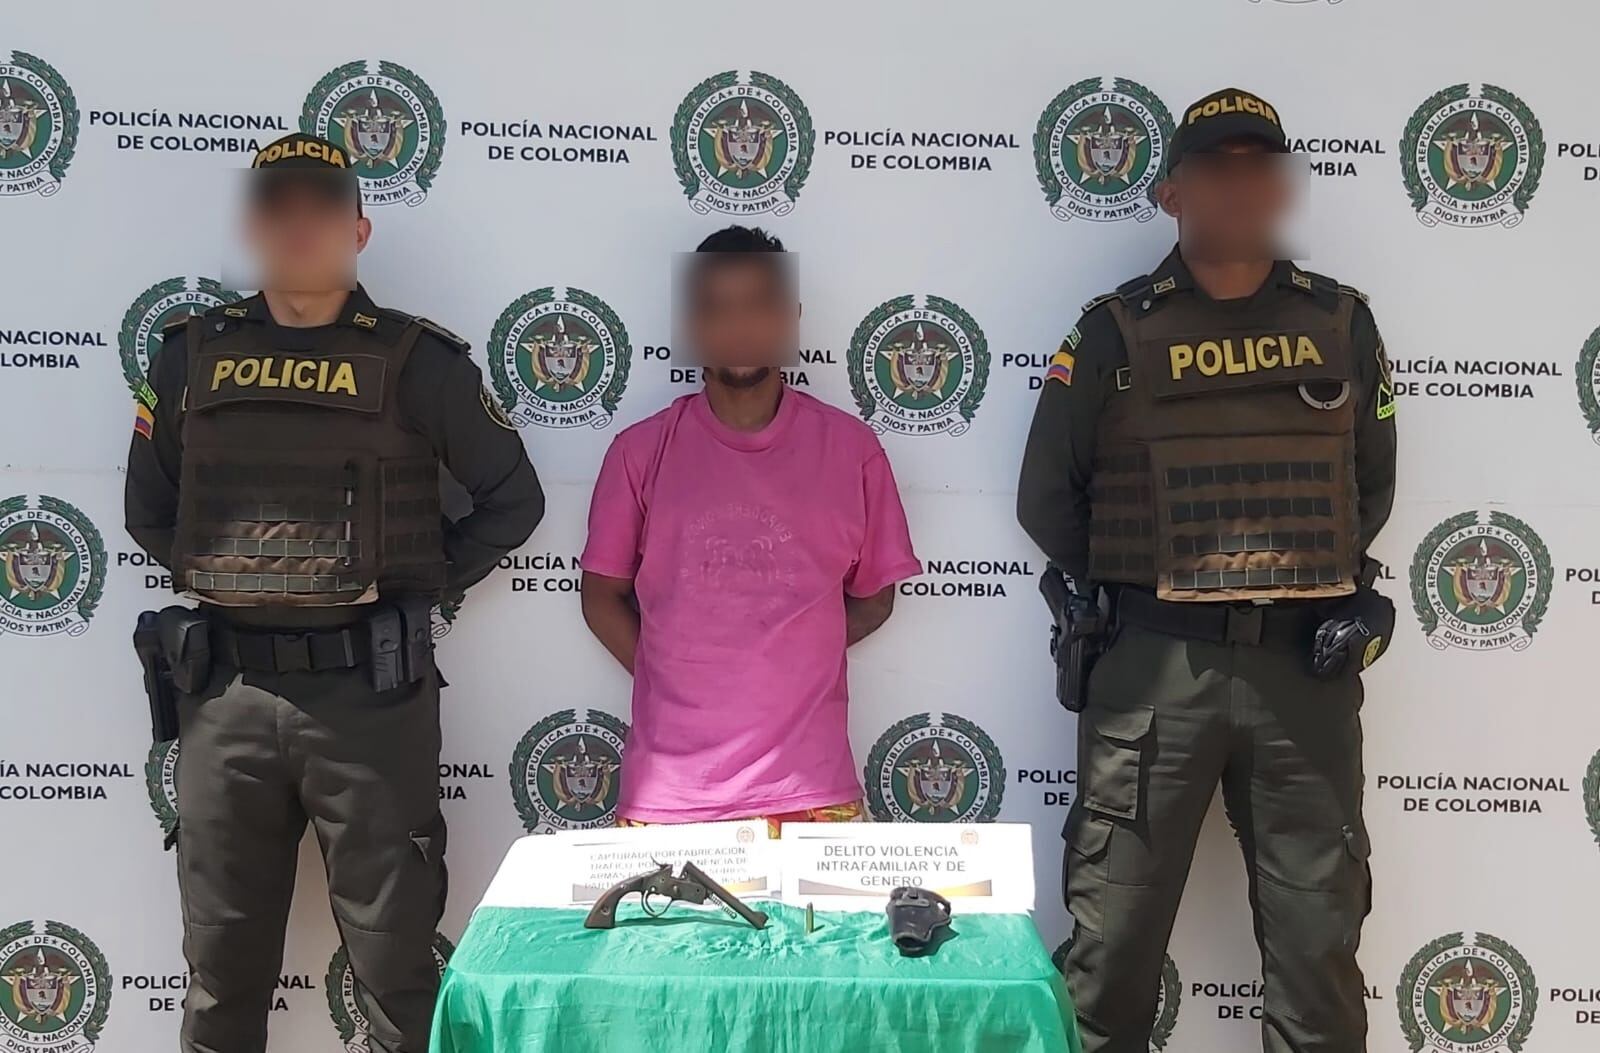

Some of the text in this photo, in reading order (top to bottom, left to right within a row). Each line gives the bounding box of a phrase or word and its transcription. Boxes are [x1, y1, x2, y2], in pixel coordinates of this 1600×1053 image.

[0, 67, 61, 132] DE COLOMBIA
[366, 77, 382, 86] DE
[394, 84, 428, 142] COLOMBIA
[1188, 96, 1278, 125] POLICIA
[90, 109, 288, 130] POLICÍA NACIONAL
[737, 87, 753, 96] DE
[764, 94, 797, 152] COLOMBIA
[1101, 94, 1117, 102] DE
[1128, 101, 1160, 158] COLOMBIA
[462, 120, 657, 140] POLICÍA NACIONAL
[824, 128, 1020, 149] POLICÍA NACIONAL
[1468, 100, 1484, 108] DE
[1495, 107, 1527, 164] COLOMBIA
[118, 135, 259, 152] DE COLOMBIA
[7, 146, 56, 179] NACIONAL
[254, 141, 345, 168] POLICIA
[489, 146, 629, 163] DE COLOMBIA
[851, 155, 992, 171] DE COLOMBIA
[374, 156, 423, 189] NACIONAL
[1310, 162, 1357, 176] MBIA
[6, 177, 46, 194] PATRIA
[742, 165, 792, 199] NACIONAL
[1104, 172, 1154, 205] NACIONAL
[373, 187, 413, 204] PATRIA
[705, 193, 731, 211] DIOS
[741, 196, 781, 213] PATRIA
[1471, 177, 1521, 211] NACIONAL
[1067, 200, 1093, 218] DIOS
[1103, 203, 1143, 220] PATRIA
[1433, 206, 1459, 224] DIOS
[1470, 208, 1509, 225] PATRIA
[185, 293, 201, 301] DE
[0, 331, 107, 346] NACIONAL
[554, 304, 569, 312] DE
[580, 310, 613, 366] COLOMBIA
[913, 311, 929, 320] DE
[940, 318, 972, 374] COLOMBIA
[1, 353, 79, 368] LOMBIA
[1003, 354, 1053, 368] POLI
[1169, 335, 1324, 380] POLICIA
[211, 357, 358, 396] POLICIA
[670, 369, 697, 384] DE
[1455, 361, 1562, 376] NACIONAL
[560, 379, 609, 412] NACIONAL
[1394, 382, 1533, 398] DE COLOMBIA
[918, 387, 967, 420] NACIONAL
[523, 407, 549, 424] DIOS
[559, 410, 598, 426] PATRIA
[881, 414, 906, 432] DIOS
[917, 417, 956, 434] PATRIA
[27, 511, 42, 520] DE
[54, 518, 89, 573] COLOMBIA
[498, 553, 565, 570] OLICÍA
[1477, 527, 1492, 535] DE
[1504, 533, 1535, 589] COLOMBIA
[928, 561, 1034, 575] NACIONAL
[145, 576, 172, 589] DE
[512, 578, 537, 591] DE
[900, 582, 1007, 597] COLOMBIA
[35, 586, 84, 620] NACIONAL
[35, 617, 75, 634] PATRIA
[1480, 602, 1530, 634] NACIONAL
[1443, 630, 1468, 647] DIOS
[1479, 632, 1518, 648] PATRIA
[575, 725, 590, 733] DE
[929, 729, 945, 737] DE
[956, 735, 988, 790] COLOMBIA
[26, 764, 134, 777] NACIONAL
[440, 764, 494, 777] ONAL
[1018, 770, 1076, 784] POLIC
[1378, 773, 1569, 791] POLICÍA NACIONAL
[0, 786, 107, 799] COLOMBIA
[1044, 792, 1070, 806] DE
[1404, 798, 1541, 813] DE COLOMBIA
[581, 809, 617, 830] NACIO
[655, 849, 676, 858] POR
[824, 845, 959, 857] DELITO VIOLENCIA
[816, 860, 965, 872] INTRAFAMILIAR Y DE
[860, 875, 923, 887] GENERO
[33, 936, 49, 945] DE
[60, 942, 94, 997] COLOMBIA
[123, 972, 187, 989] POLICÍ
[1463, 948, 1478, 956] DE
[1489, 954, 1520, 1008] COLOMBIA
[150, 998, 174, 1011] DE
[1218, 1006, 1243, 1019] DE
[42, 1010, 90, 1043] NACIONAL
[1576, 1011, 1600, 1024] DE
[1466, 1021, 1515, 1053] NACIONAL
